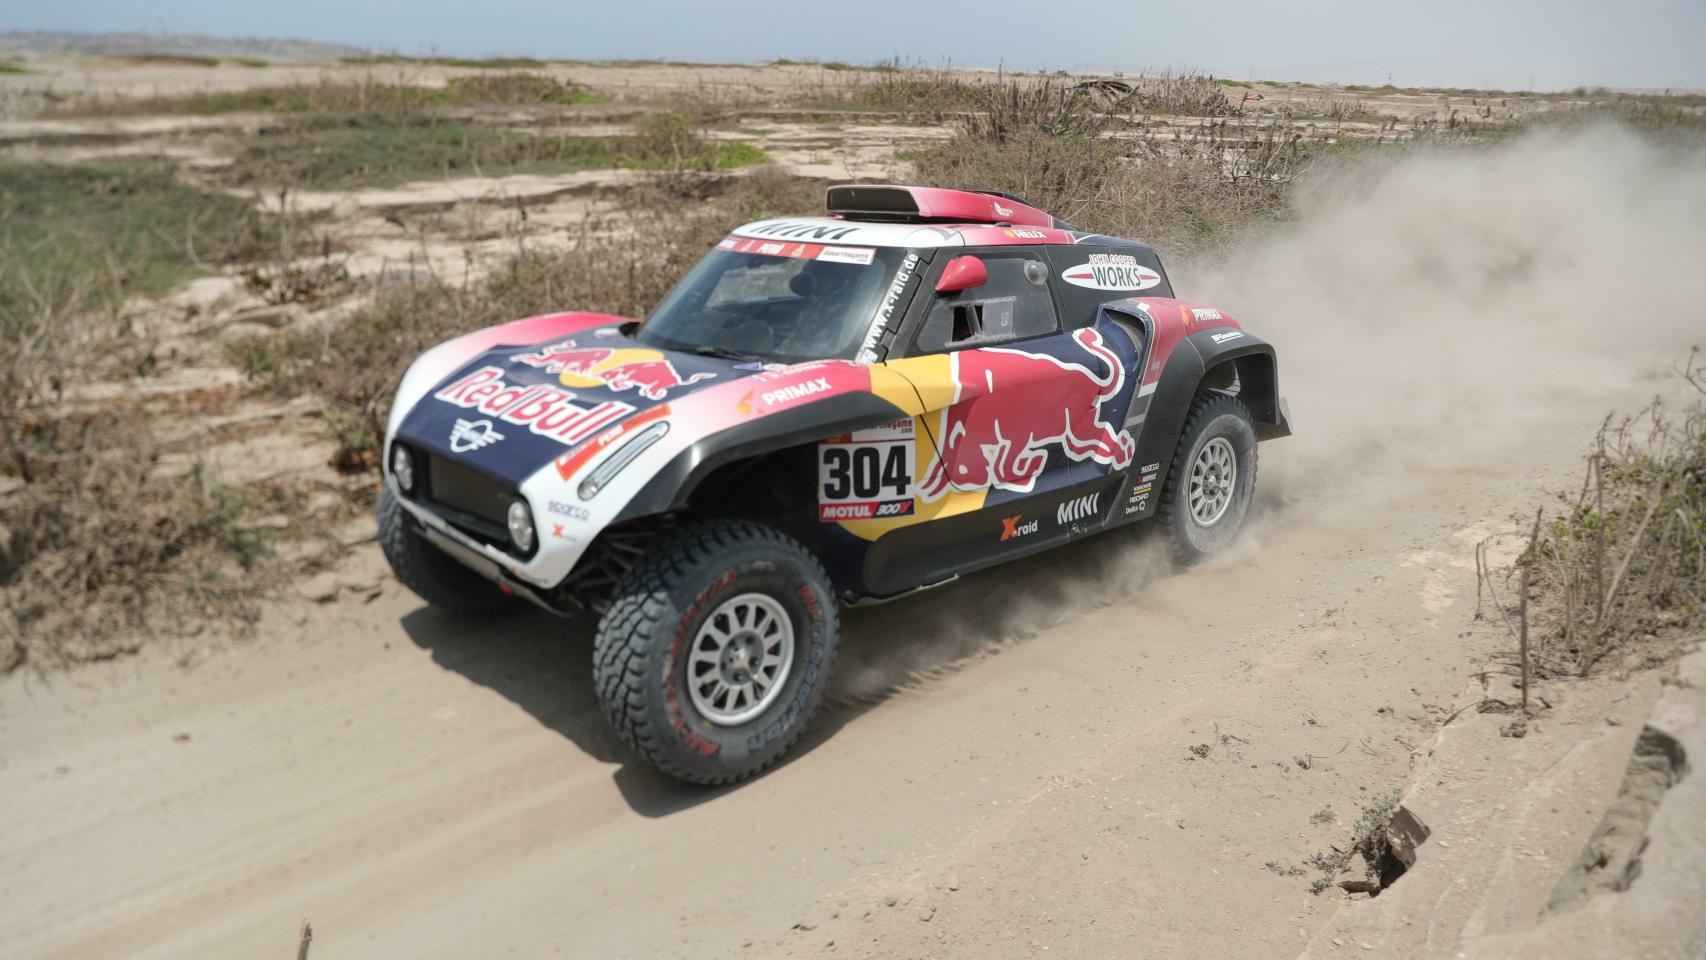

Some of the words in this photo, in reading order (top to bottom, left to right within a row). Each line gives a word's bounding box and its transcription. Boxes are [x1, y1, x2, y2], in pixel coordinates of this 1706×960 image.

[749, 222, 861, 240] MINI
[1089, 254, 1110, 265] JOHN
[1109, 254, 1137, 266] COOPER
[1092, 266, 1141, 287] WORKS
[761, 377, 832, 406] PRIMAX
[823, 446, 911, 499] 304
[822, 505, 872, 518] MOTUL
[1057, 492, 1100, 525] MINI
